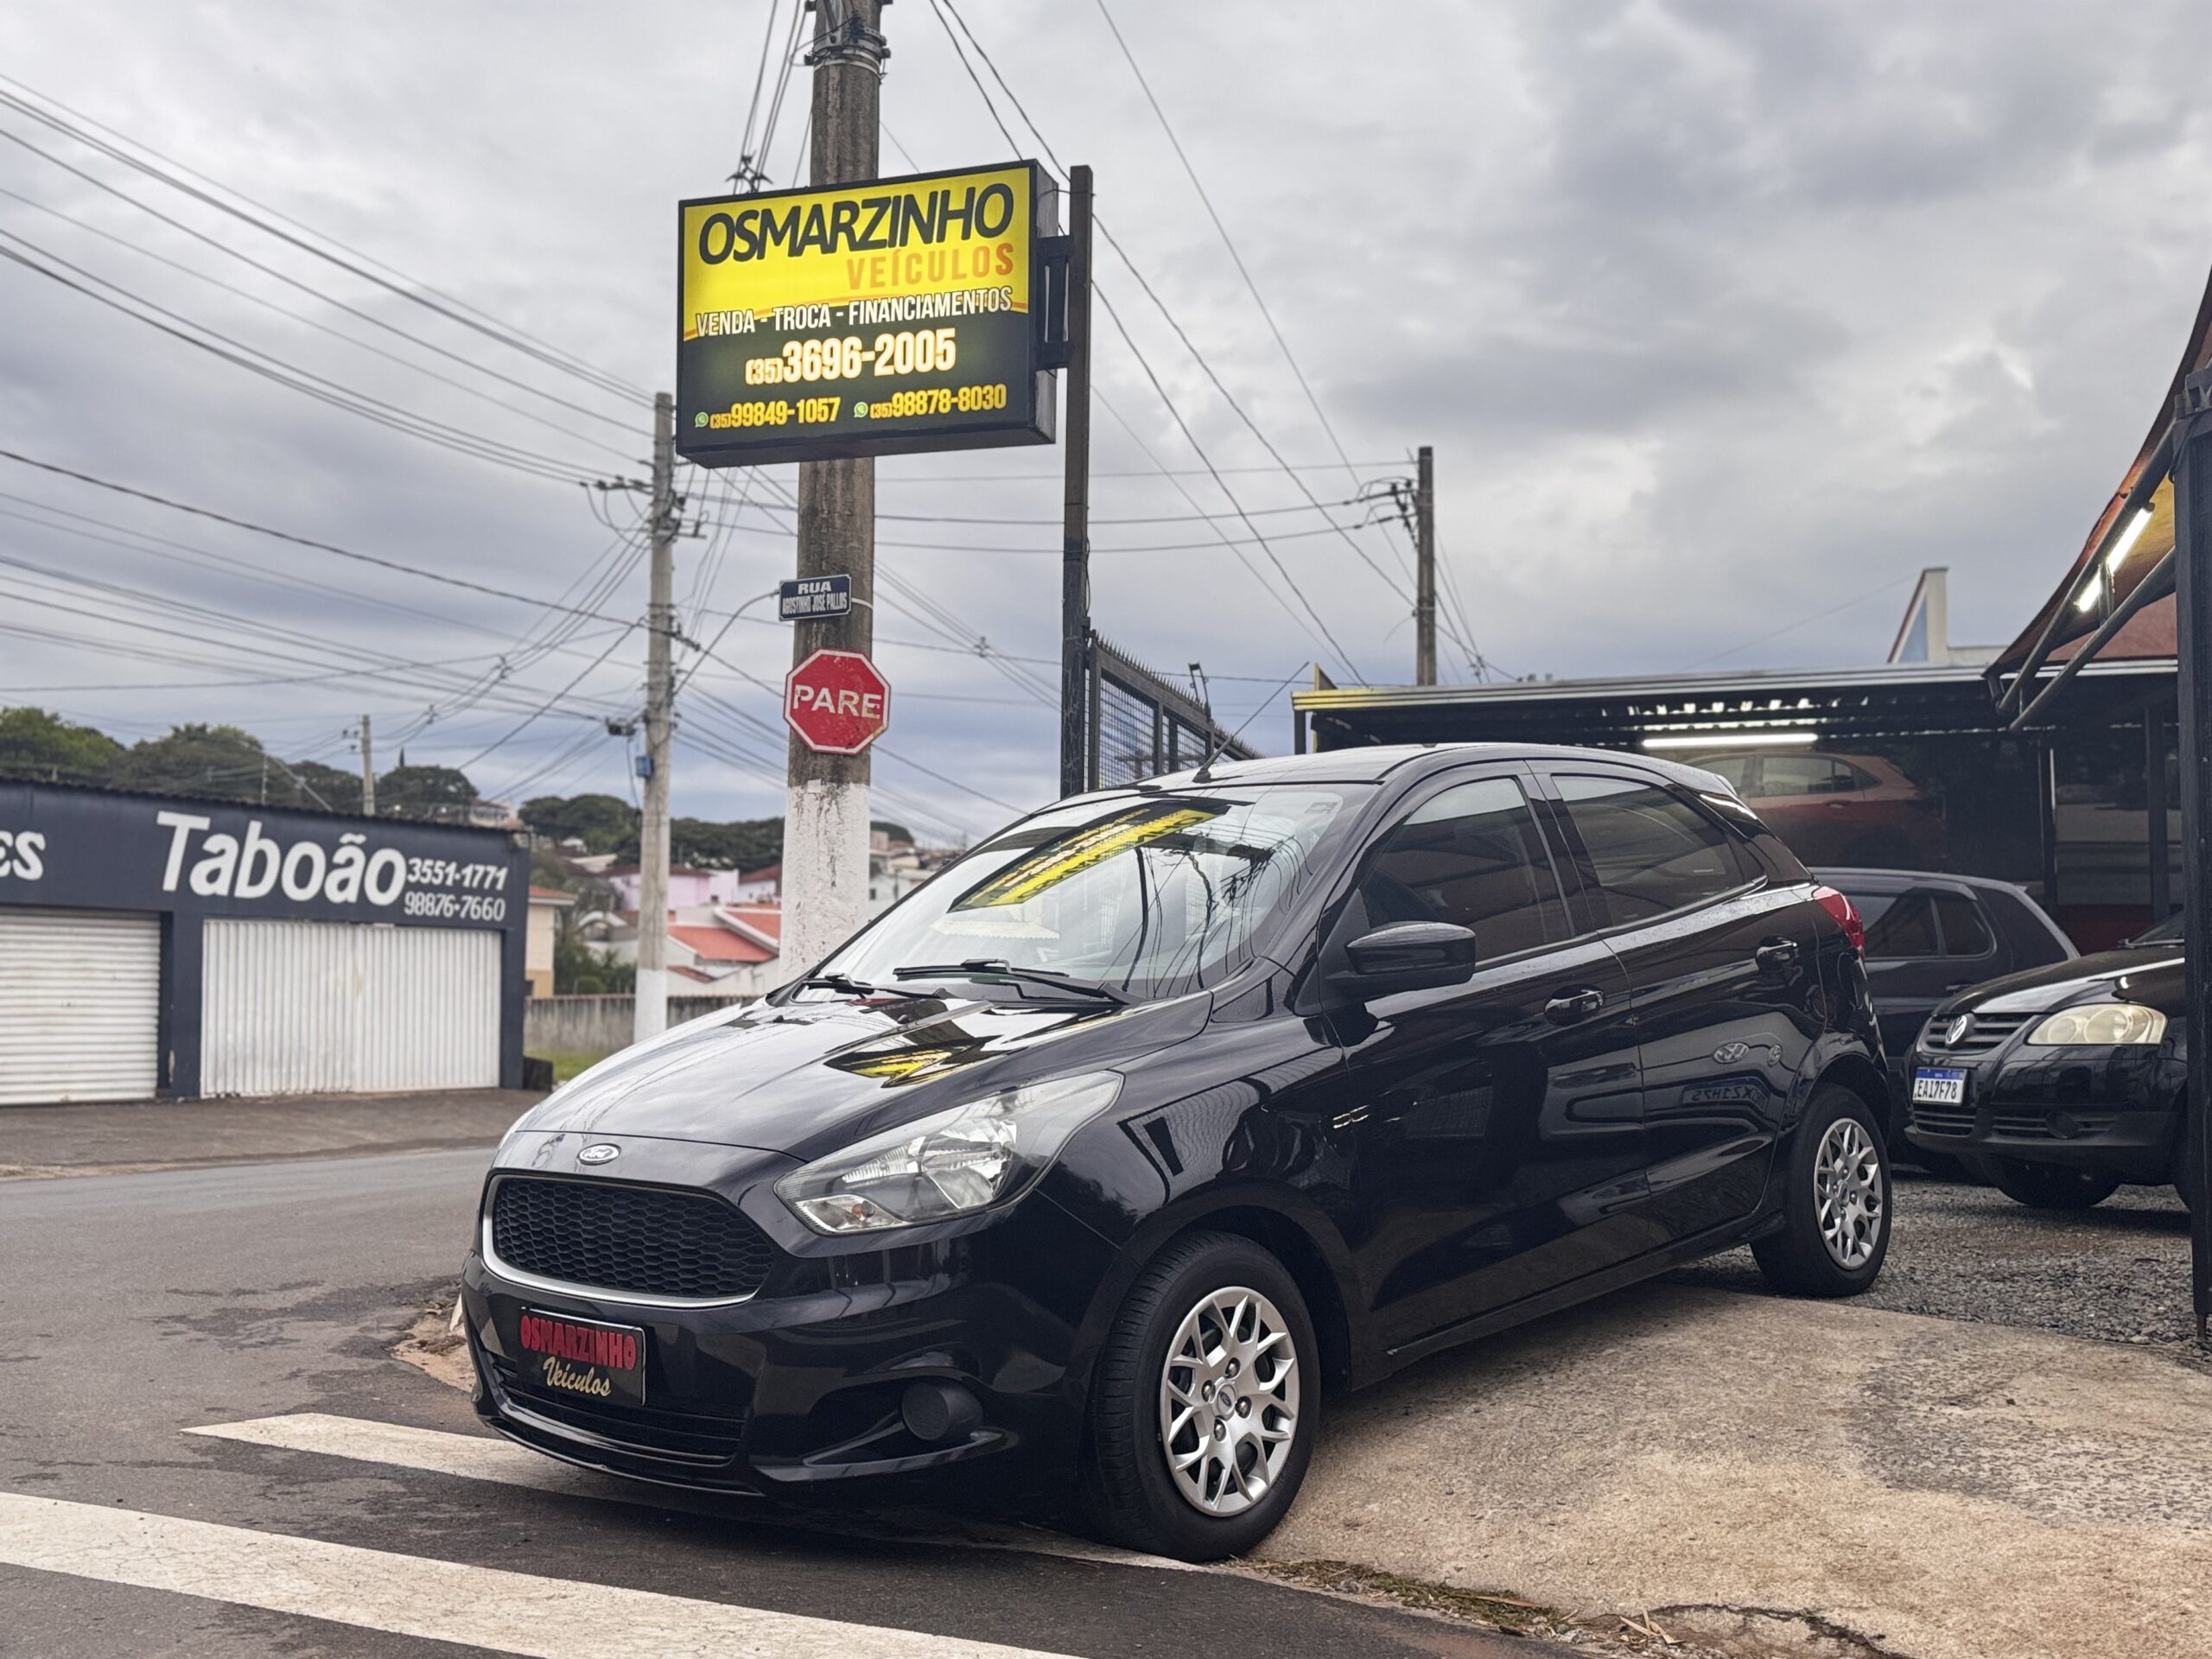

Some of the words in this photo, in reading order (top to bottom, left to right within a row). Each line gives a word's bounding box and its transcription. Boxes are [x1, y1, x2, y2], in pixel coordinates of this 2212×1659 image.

[698, 182, 1014, 265] OSMARZINHO
[846, 243, 1014, 290] VEÍCULOS
[696, 308, 756, 337] VENDA
[772, 303, 831, 332] TROCA
[848, 286, 1013, 327] FINANCIAMENTOS
[798, 581, 832, 595] RUA
[792, 684, 882, 719] PARE
[156, 810, 406, 906] Taboão
[520, 1314, 637, 1371] OSMARZINHO
